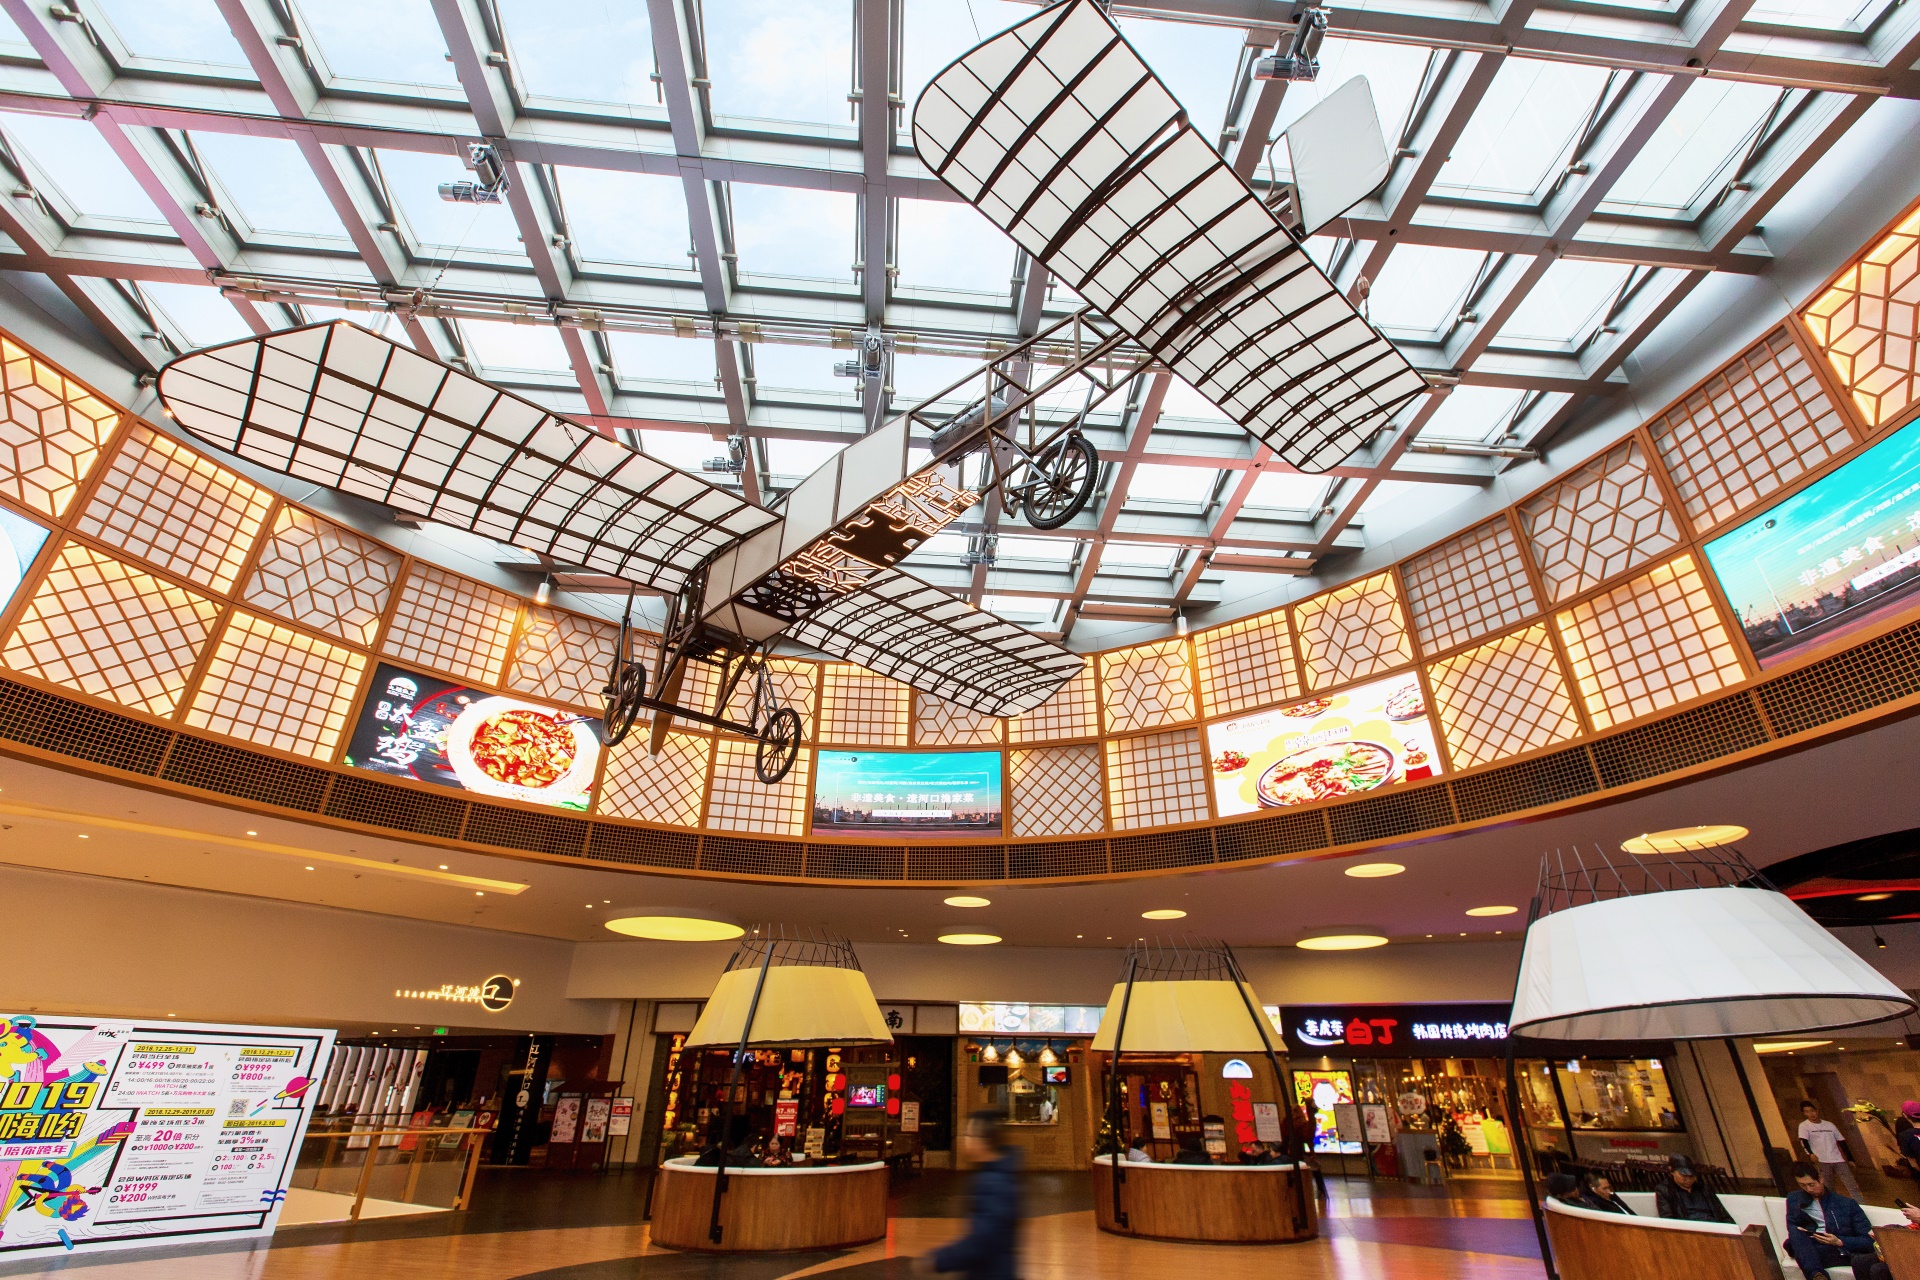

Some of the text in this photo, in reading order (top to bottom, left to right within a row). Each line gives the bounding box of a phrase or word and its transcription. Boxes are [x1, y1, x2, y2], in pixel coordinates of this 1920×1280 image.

[1346, 1017, 1398, 1045] 白丁
[1413, 1022, 1508, 1040] 韩国传统烤肉店
[0, 1082, 100, 1110] 019
[0, 1145, 68, 1157] 陪你跨年
